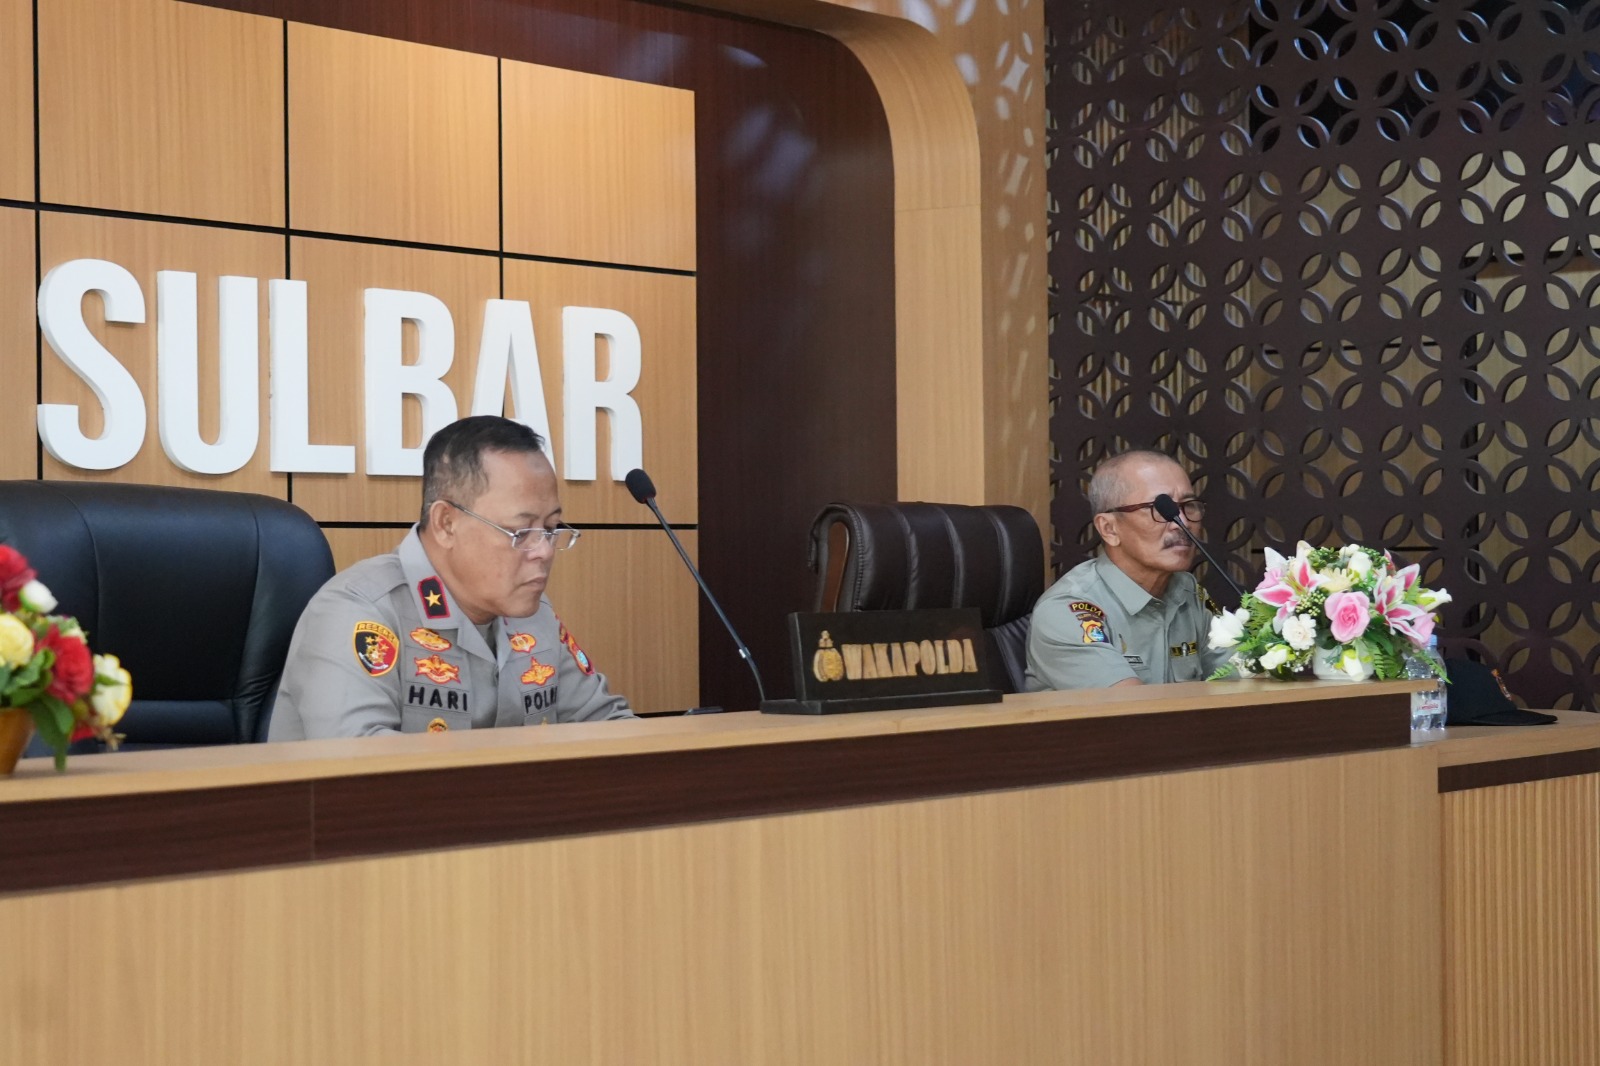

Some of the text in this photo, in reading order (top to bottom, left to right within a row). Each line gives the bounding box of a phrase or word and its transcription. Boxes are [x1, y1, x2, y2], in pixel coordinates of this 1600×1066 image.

[36, 257, 644, 482] SULBAR
[1071, 602, 1102, 617] POLDA
[841, 638, 978, 680] WAKAPOLDA
[408, 684, 468, 712] HARI
